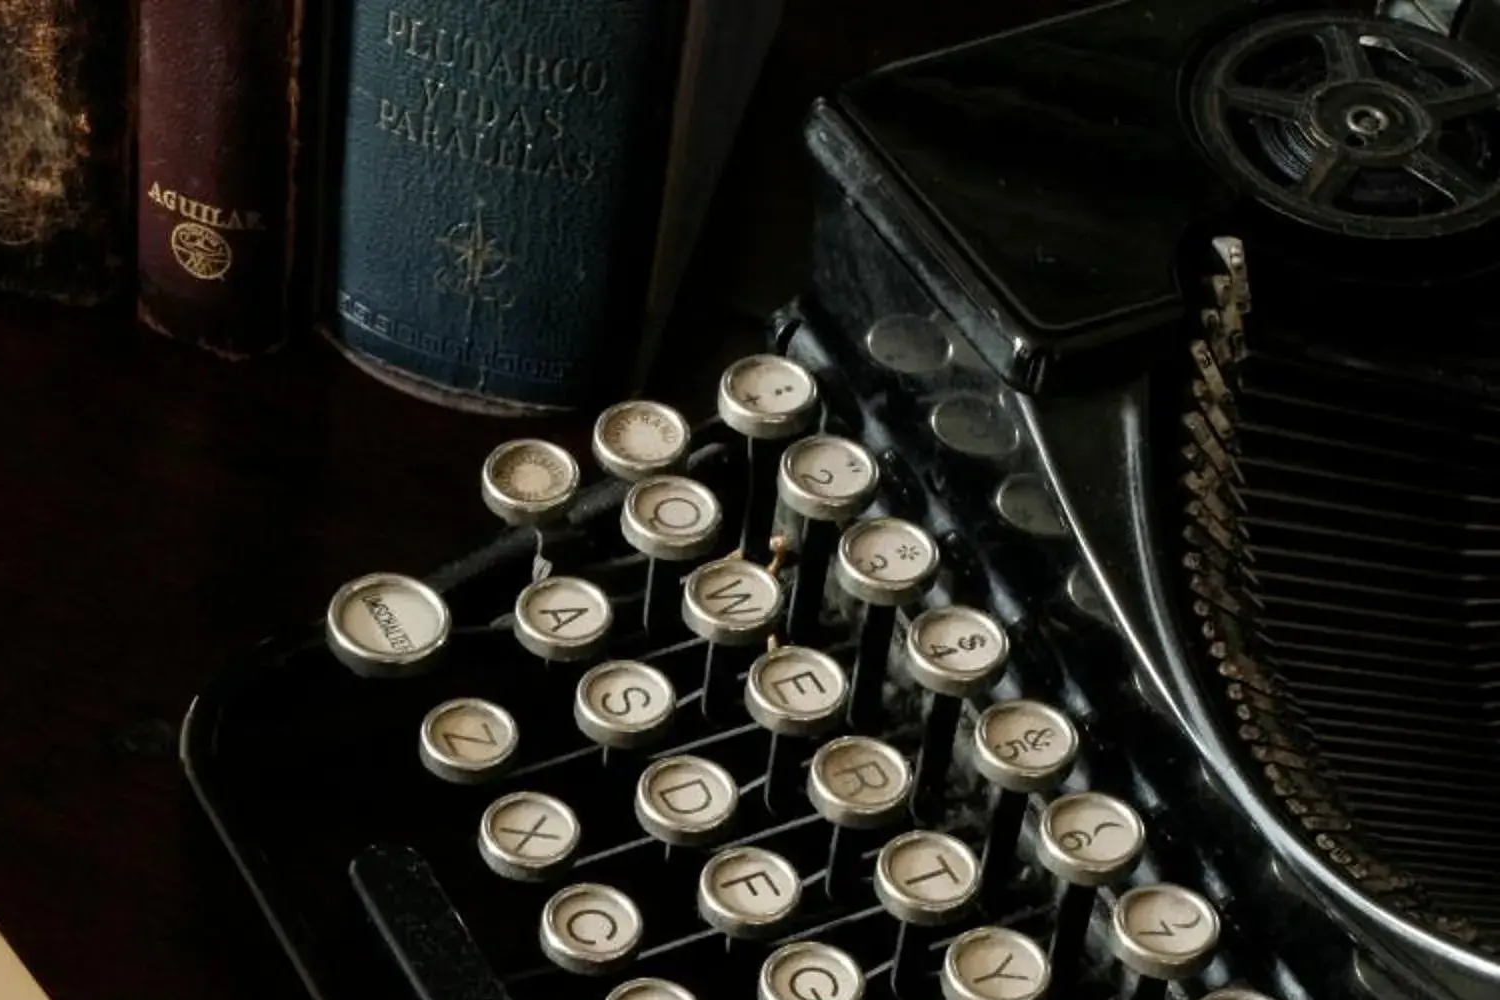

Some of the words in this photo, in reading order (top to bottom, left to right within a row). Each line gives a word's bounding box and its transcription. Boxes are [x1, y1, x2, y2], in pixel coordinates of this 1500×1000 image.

[386, 9, 610, 97] PLUTARCO
[423, 77, 565, 141] VIDAS
[376, 96, 596, 182] PARALELAS
[147, 178, 266, 233] AGUILAR
[799, 468, 834, 487] 2
[648, 495, 702, 530] Q
[706, 578, 762, 623] W
[539, 606, 589, 633] A
[600, 686, 652, 718] S
[774, 671, 828, 705] E
[441, 720, 495, 760] Z
[994, 741, 1029, 763] 5
[833, 758, 890, 796] R
[661, 778, 713, 815] D
[502, 814, 562, 854] X
[1059, 830, 1092, 853] 6
[719, 870, 782, 901] F
[905, 855, 960, 887] T
[565, 907, 620, 946] C
[1136, 919, 1175, 940] 7
[972, 953, 1031, 988] Y
